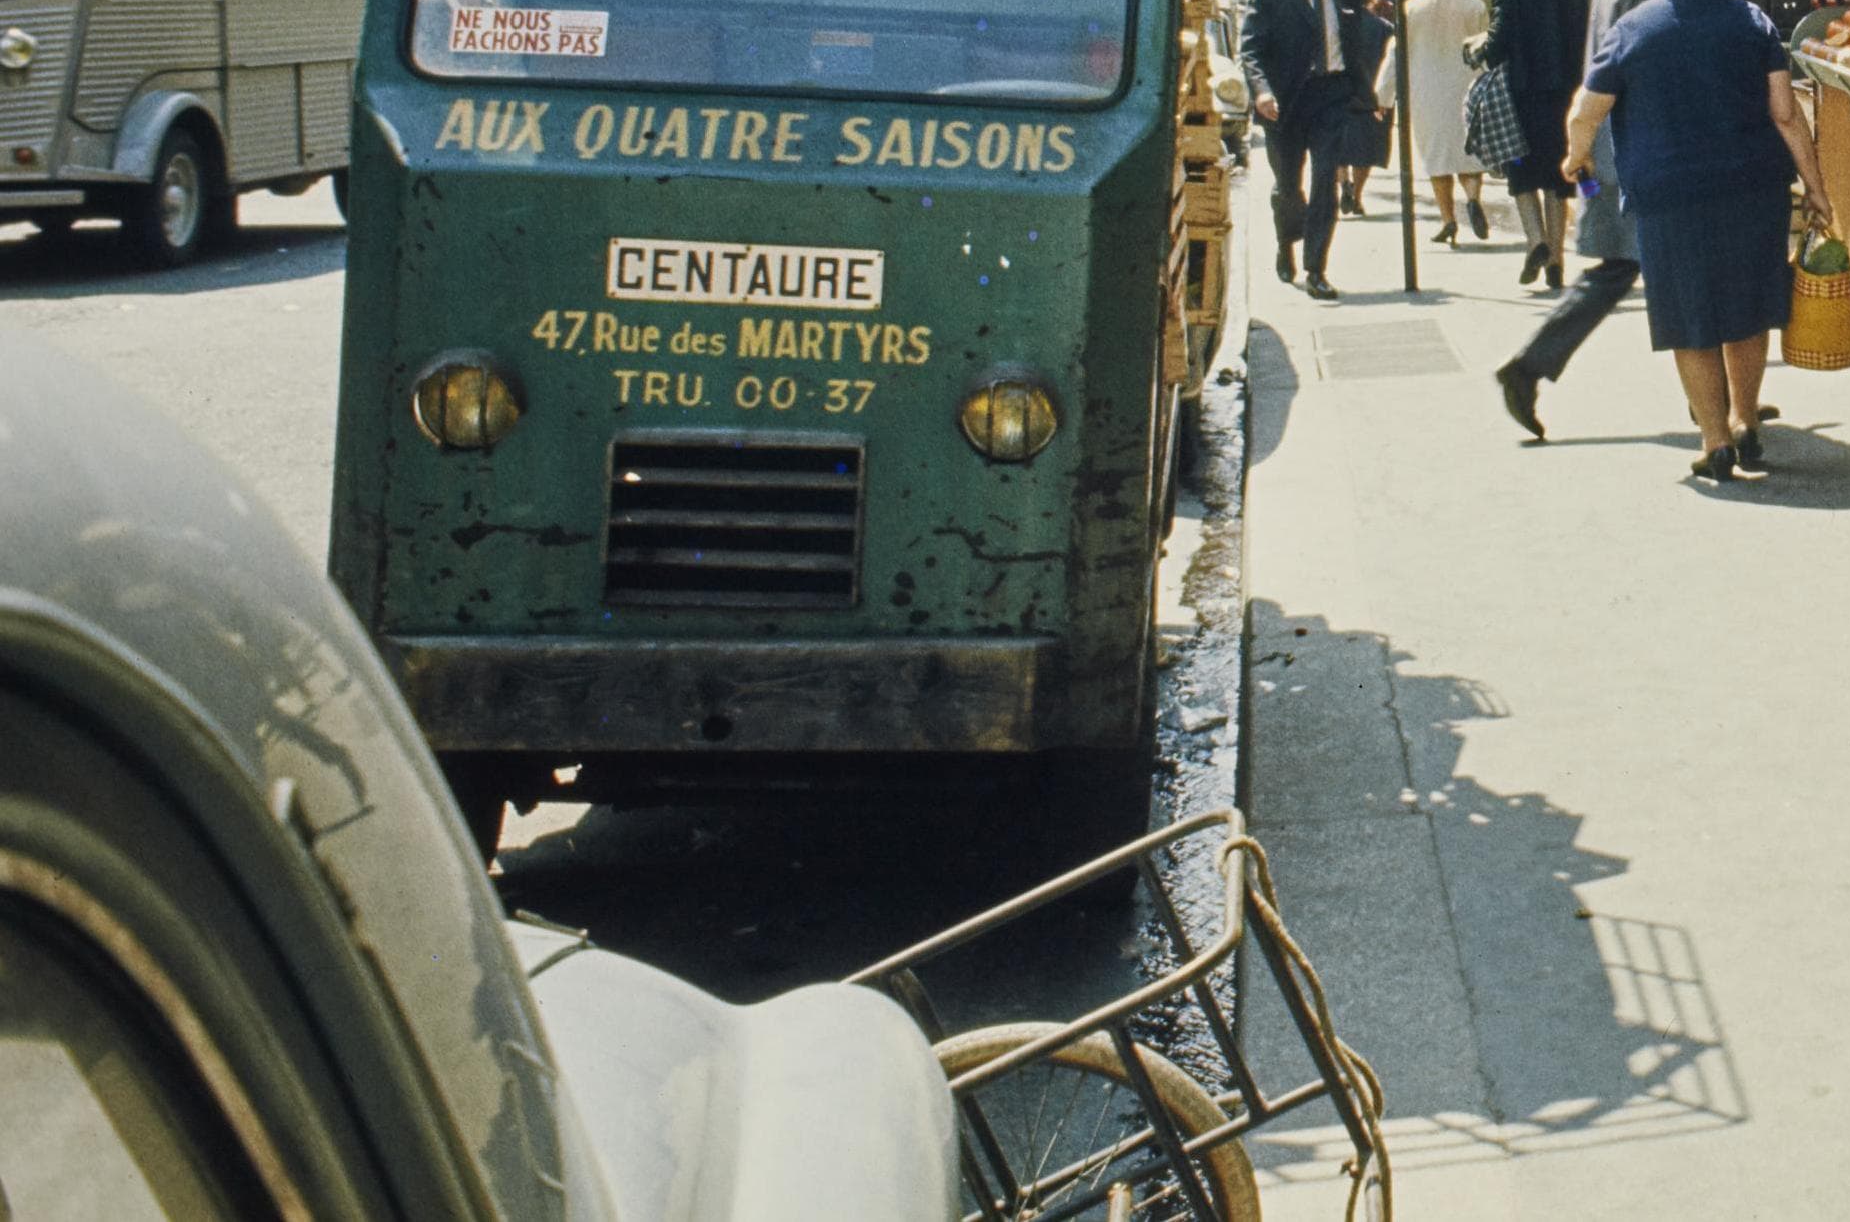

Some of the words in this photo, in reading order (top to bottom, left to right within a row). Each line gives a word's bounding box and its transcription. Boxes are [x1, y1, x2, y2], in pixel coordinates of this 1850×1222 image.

[452, 31, 551, 52] FACHONS
[558, 34, 600, 54] PAS
[456, 9, 483, 29] NE
[493, 10, 551, 32] NOUS
[435, 98, 550, 153] AUX
[574, 104, 810, 162] QUATRE
[834, 116, 1078, 173] SAISONS
[616, 245, 874, 301] CENTAURE
[594, 312, 662, 354] Rue
[669, 321, 728, 356] des
[737, 317, 933, 366] MARTYRS
